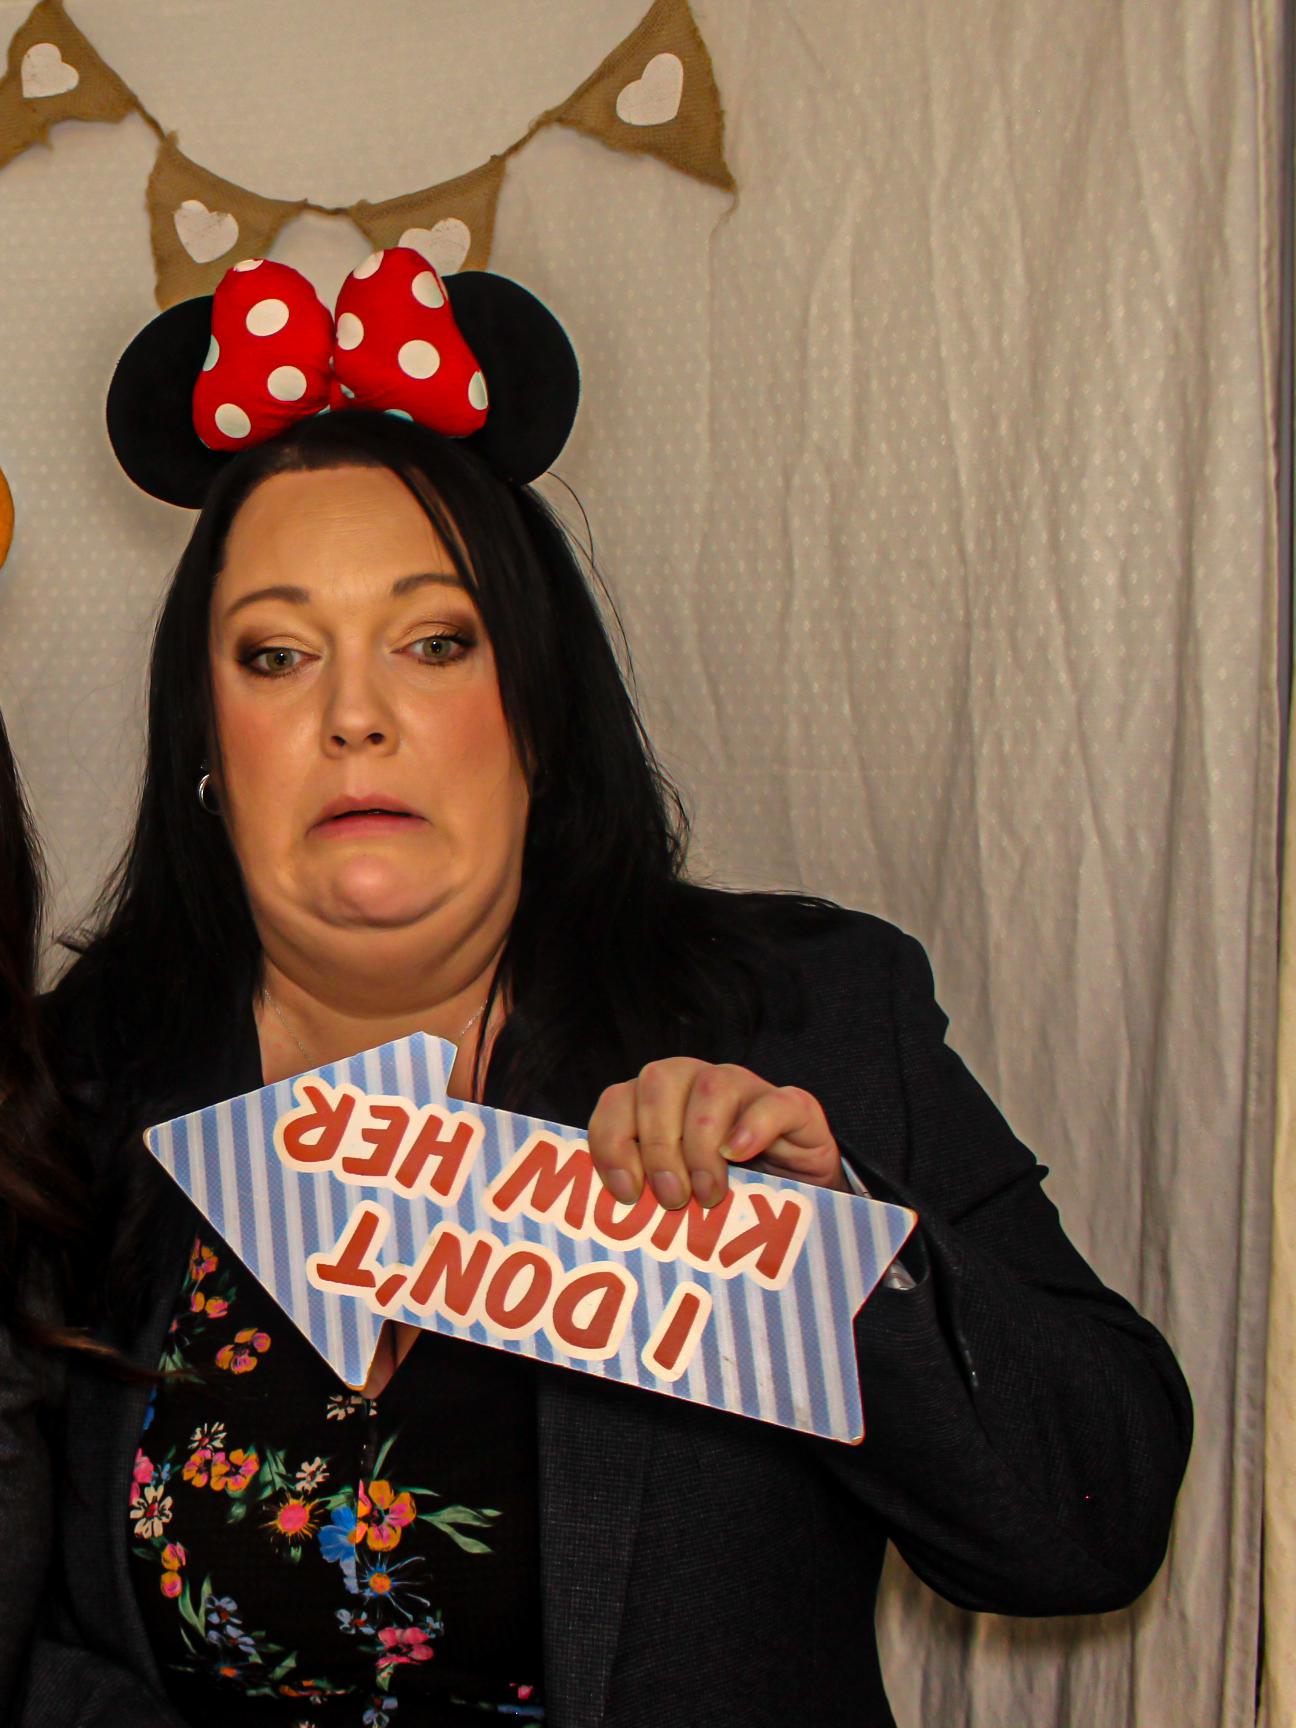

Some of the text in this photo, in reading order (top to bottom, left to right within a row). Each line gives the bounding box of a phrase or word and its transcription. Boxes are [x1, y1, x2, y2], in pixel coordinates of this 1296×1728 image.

[283, 1086, 801, 1280] KNOW HER
[316, 1210, 700, 1371] I DON'T
